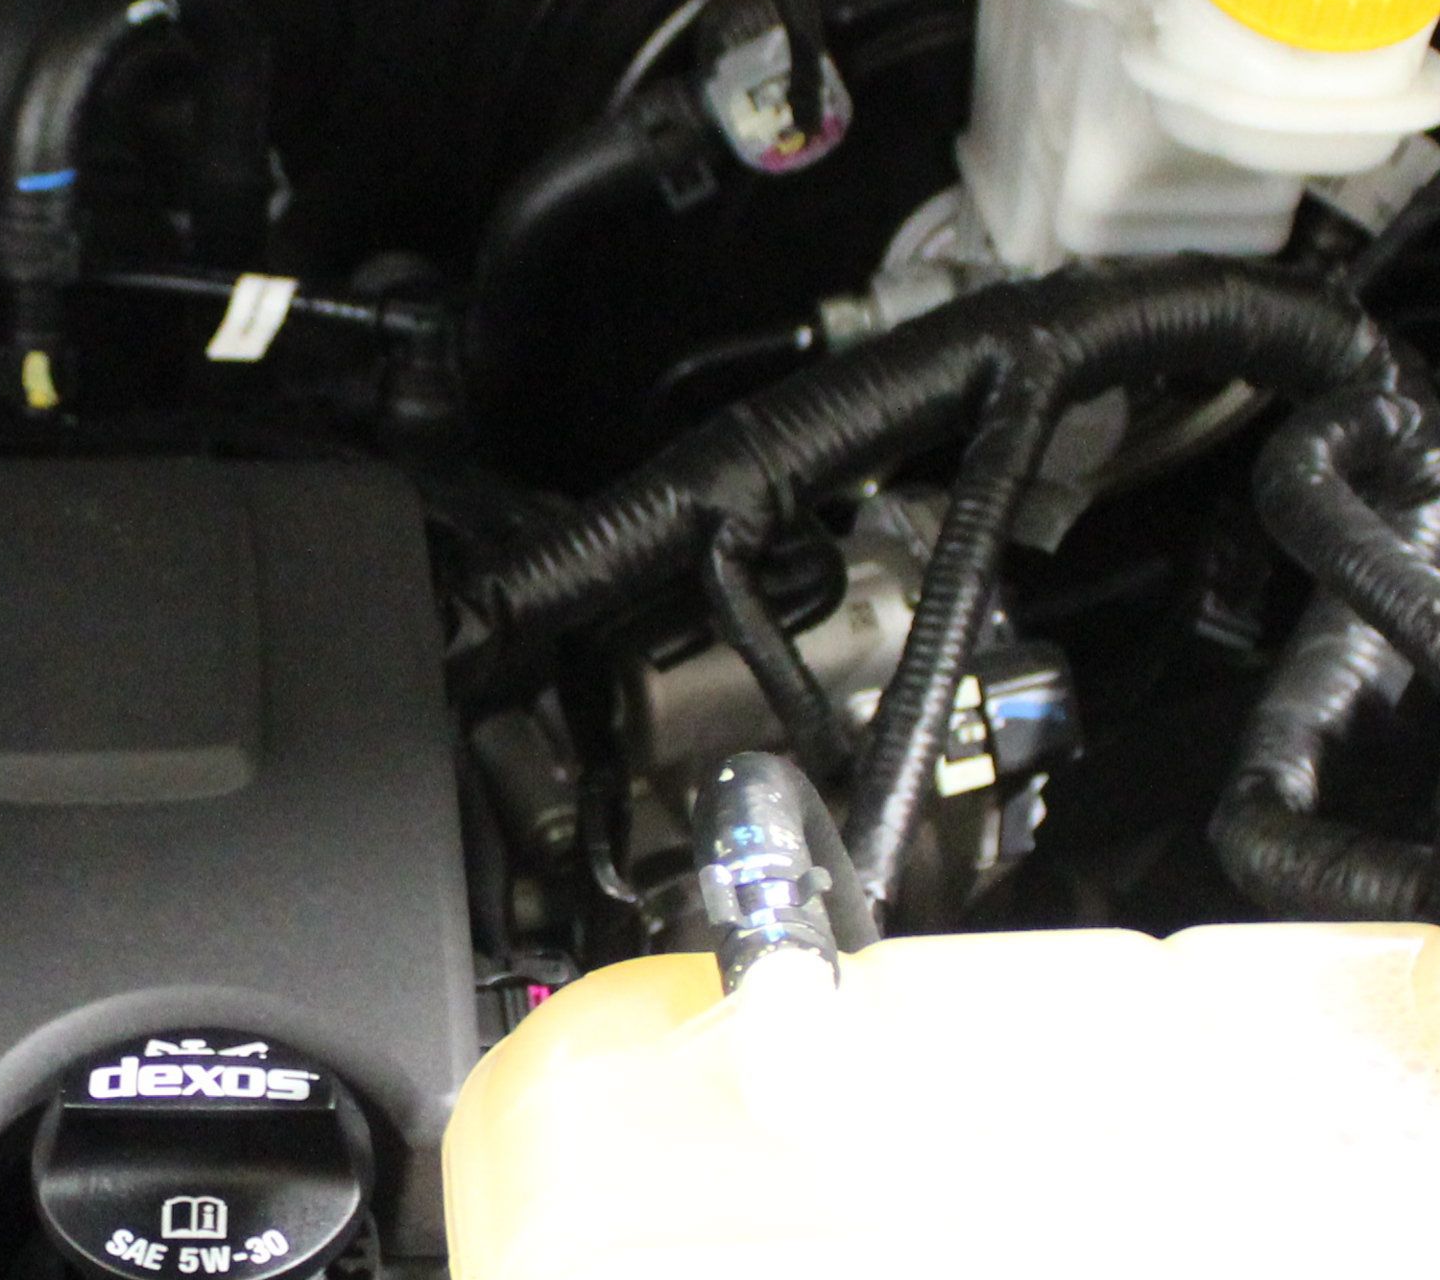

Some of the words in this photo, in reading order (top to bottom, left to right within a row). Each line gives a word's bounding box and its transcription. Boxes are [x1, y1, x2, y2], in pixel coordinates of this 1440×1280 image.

[88, 1056, 311, 1102] dexos
[105, 1228, 169, 1271] SAE
[177, 1229, 291, 1274] 5W-30
